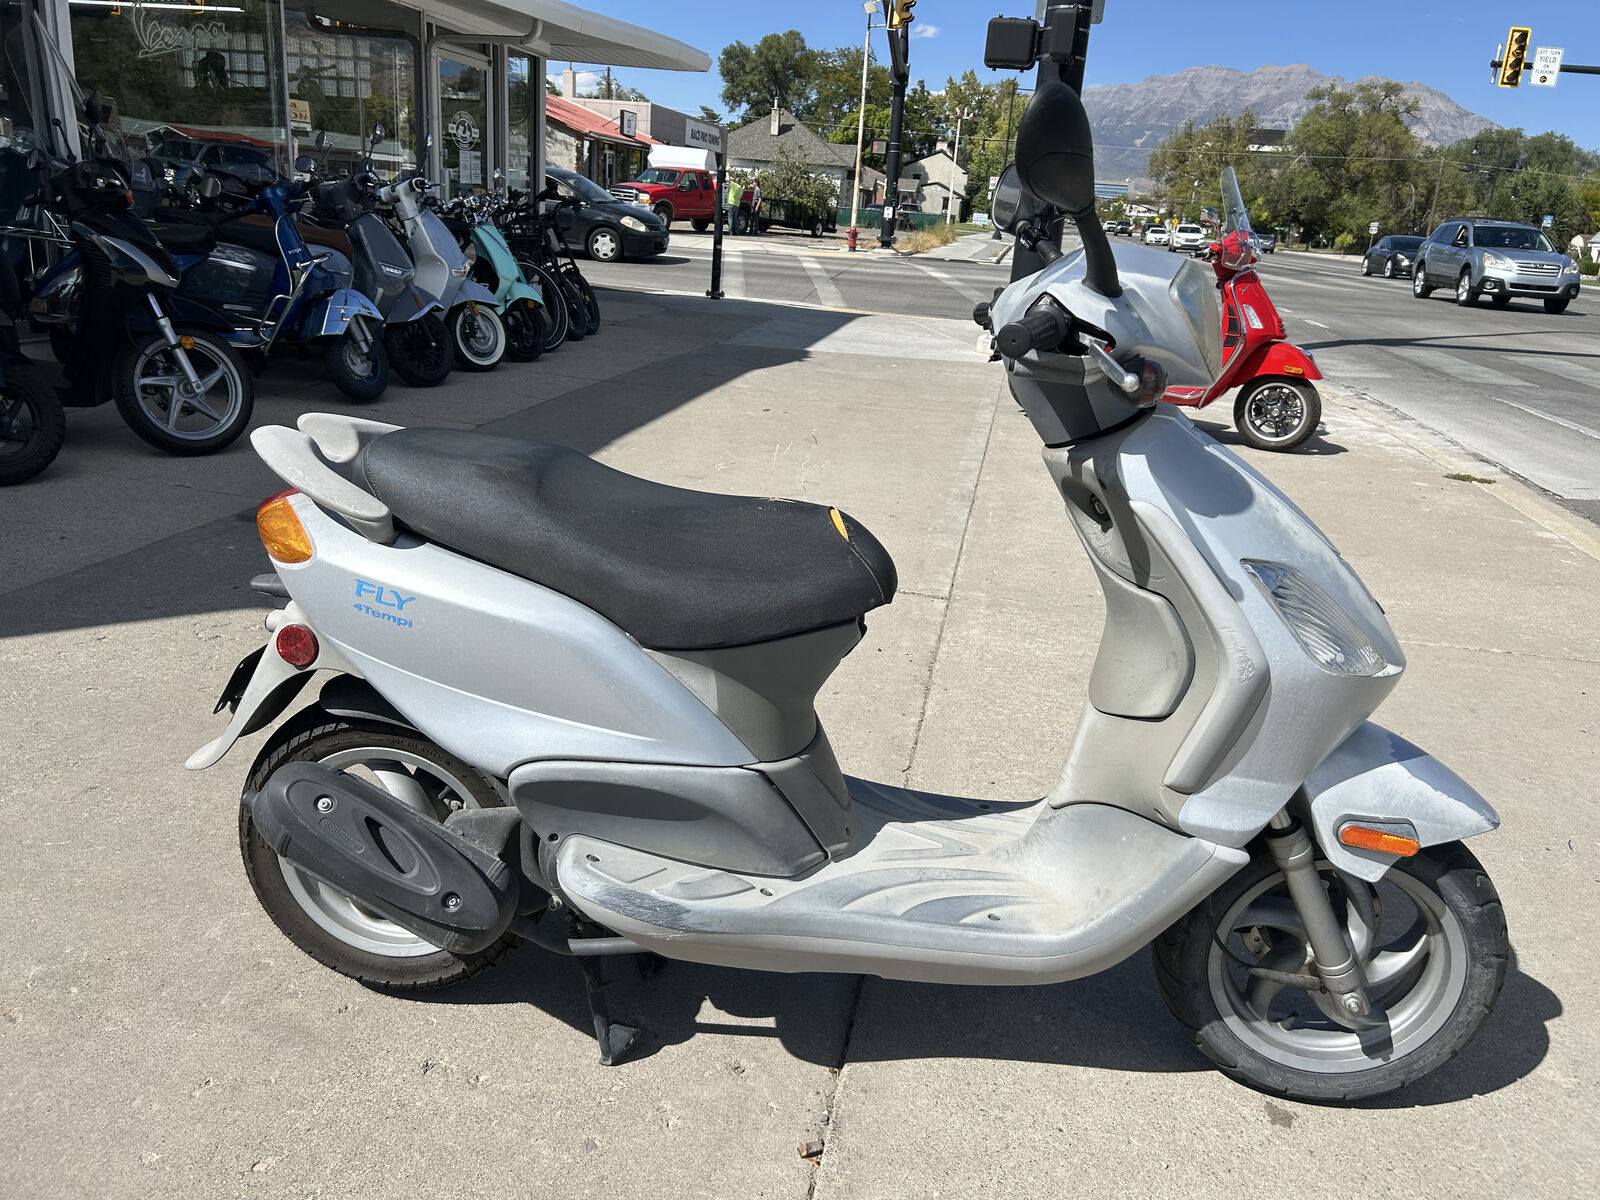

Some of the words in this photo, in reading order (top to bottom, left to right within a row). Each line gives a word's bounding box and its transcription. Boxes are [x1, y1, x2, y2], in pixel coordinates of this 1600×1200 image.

[132, 0, 232, 58] Vespa
[1540, 56, 1557, 64] YIELD
[691, 128, 700, 141] RACE
[700, 131, 708, 143] PRO
[708, 134, 720, 146] TUNING
[355, 578, 416, 611] FLY
[353, 603, 413, 629] 4Tempi
